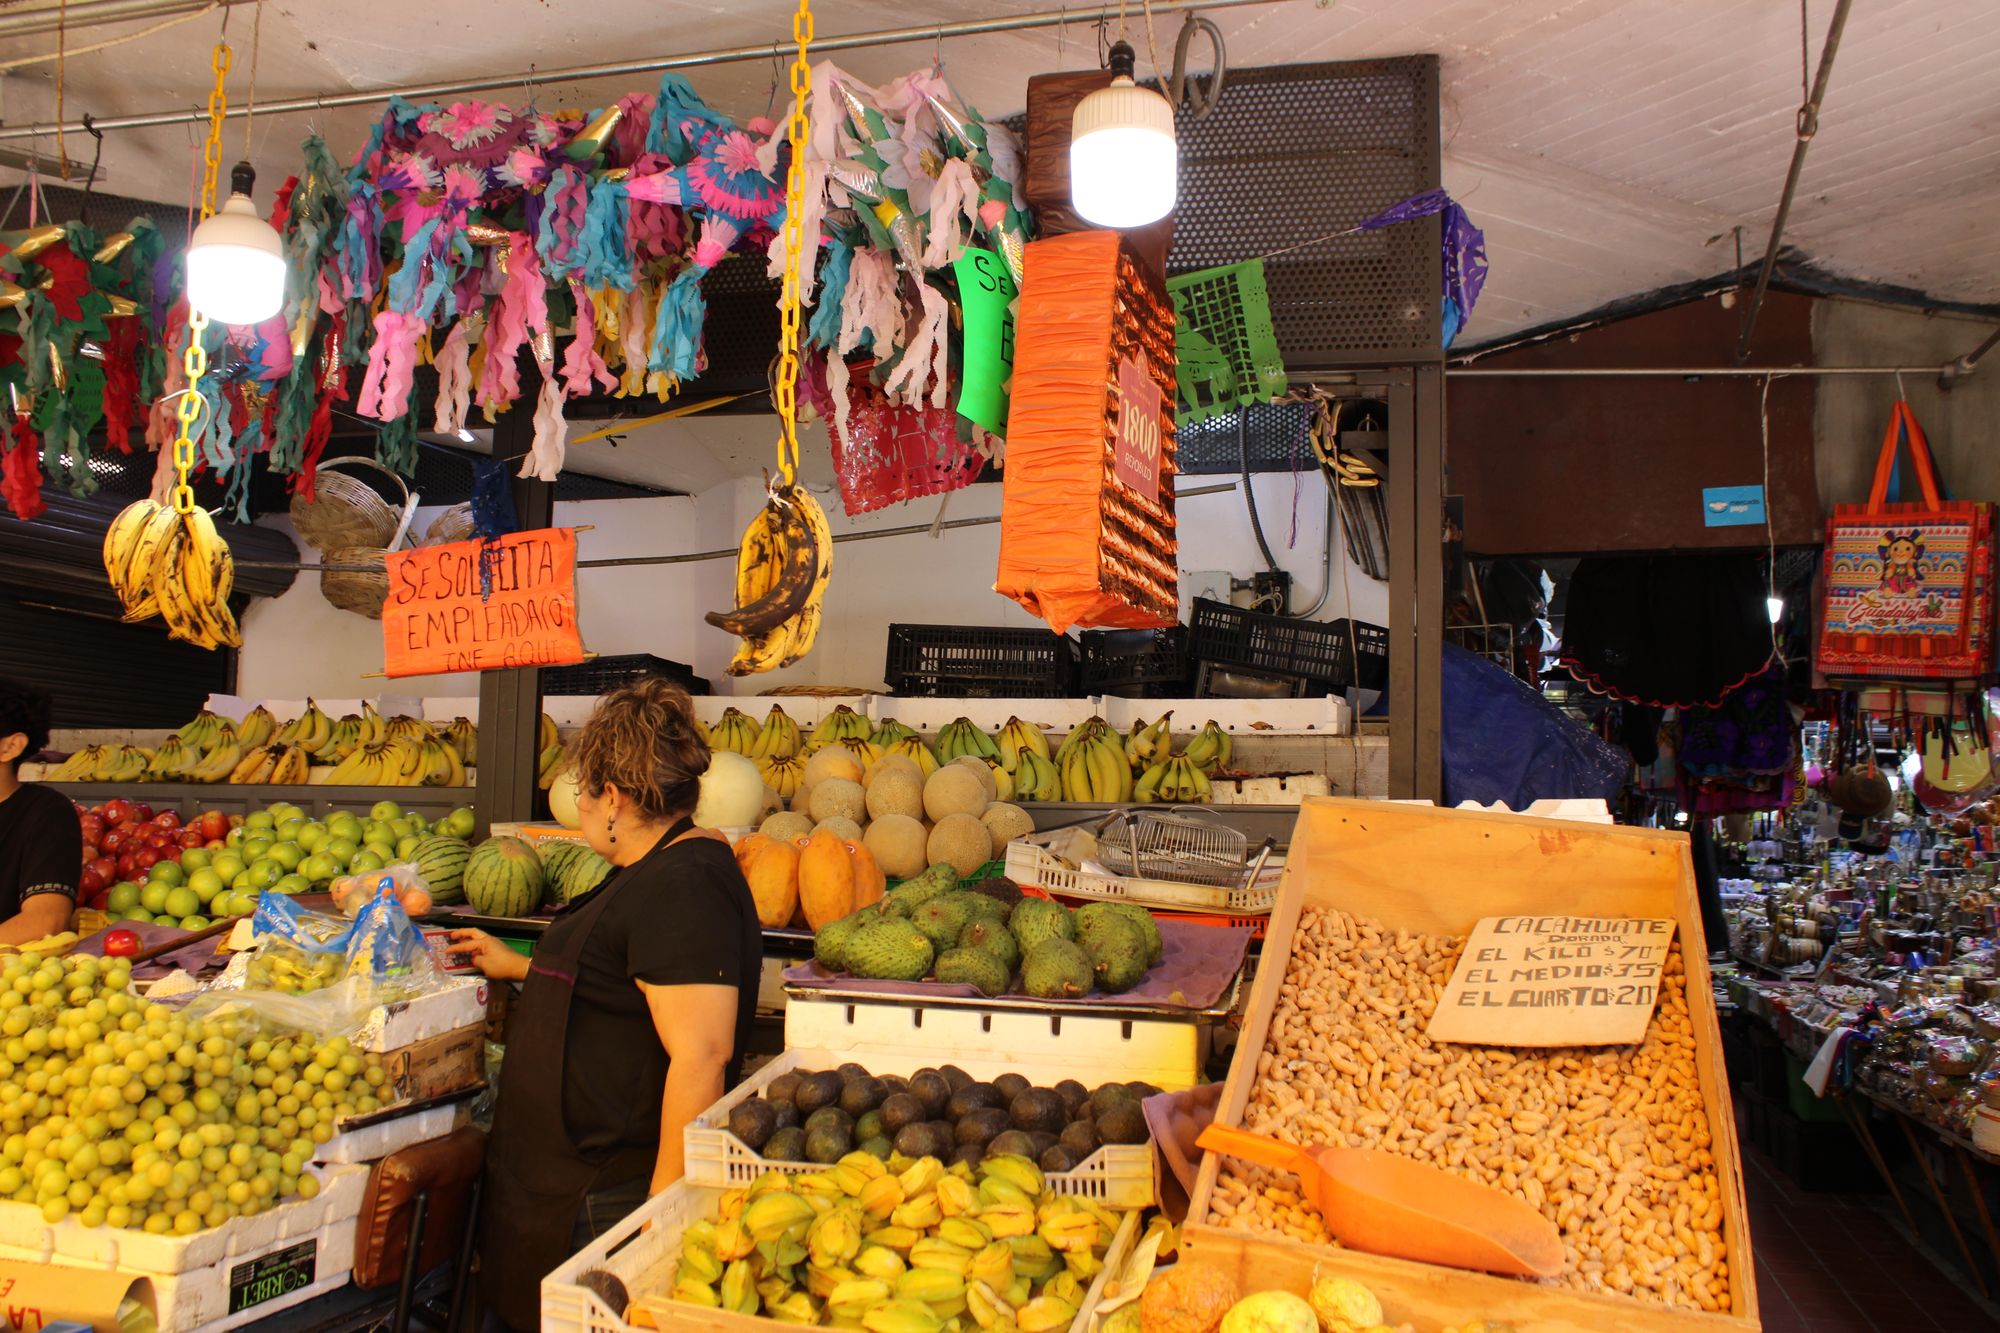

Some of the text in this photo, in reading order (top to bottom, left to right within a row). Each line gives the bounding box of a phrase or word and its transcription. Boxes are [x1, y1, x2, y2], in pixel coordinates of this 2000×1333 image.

[975, 256, 1008, 296] SE
[1124, 399, 1158, 461] 1800
[396, 559, 431, 605] SE
[1848, 603, 1944, 625] Guadalajara
[503, 640, 561, 667] AQUI
[1492, 917, 1667, 934] CACAHUATE
[1476, 948, 1508, 962] EL
[1464, 969, 1499, 984] EL
[1509, 964, 1602, 982] MEDIO
[1457, 990, 1504, 1007] EL
[1507, 986, 1609, 1008] CUARTO
[236, 1267, 308, 1310] SORBET
